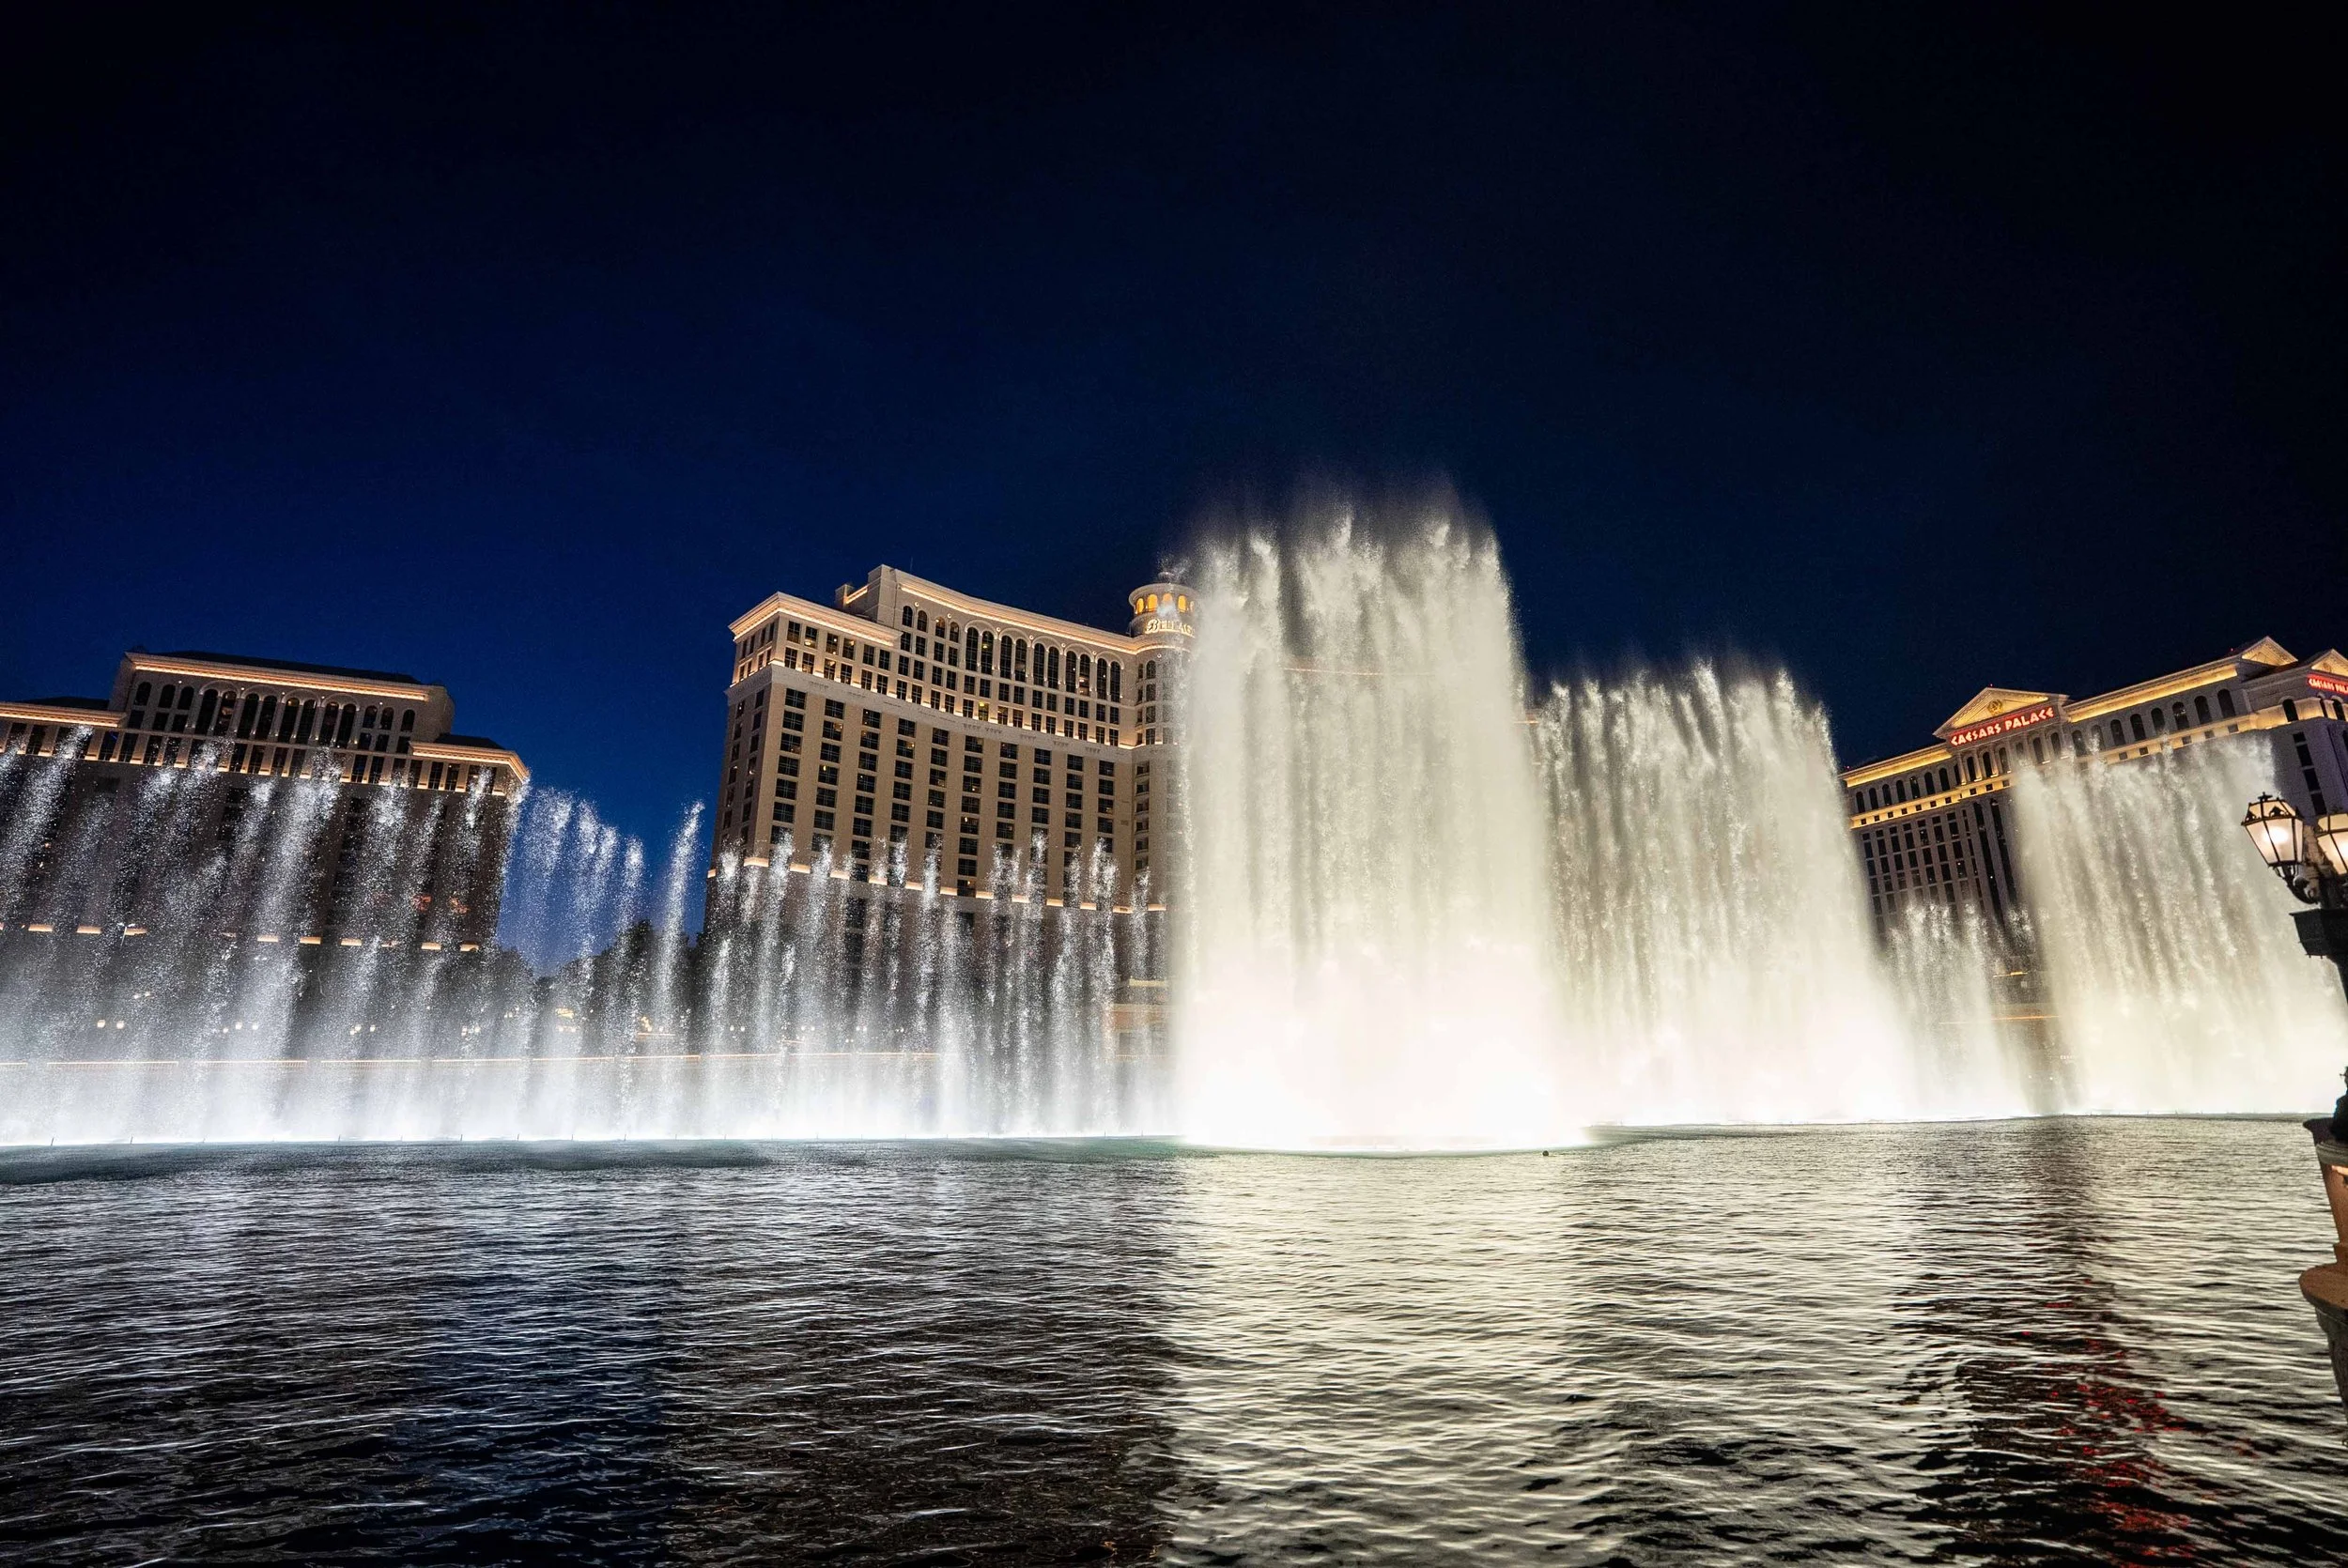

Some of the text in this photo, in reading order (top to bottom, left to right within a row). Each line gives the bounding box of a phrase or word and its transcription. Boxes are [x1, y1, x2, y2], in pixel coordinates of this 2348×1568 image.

[1145, 619, 1195, 638] BELLAG
[1951, 707, 2054, 746] CAESARS PALACE
